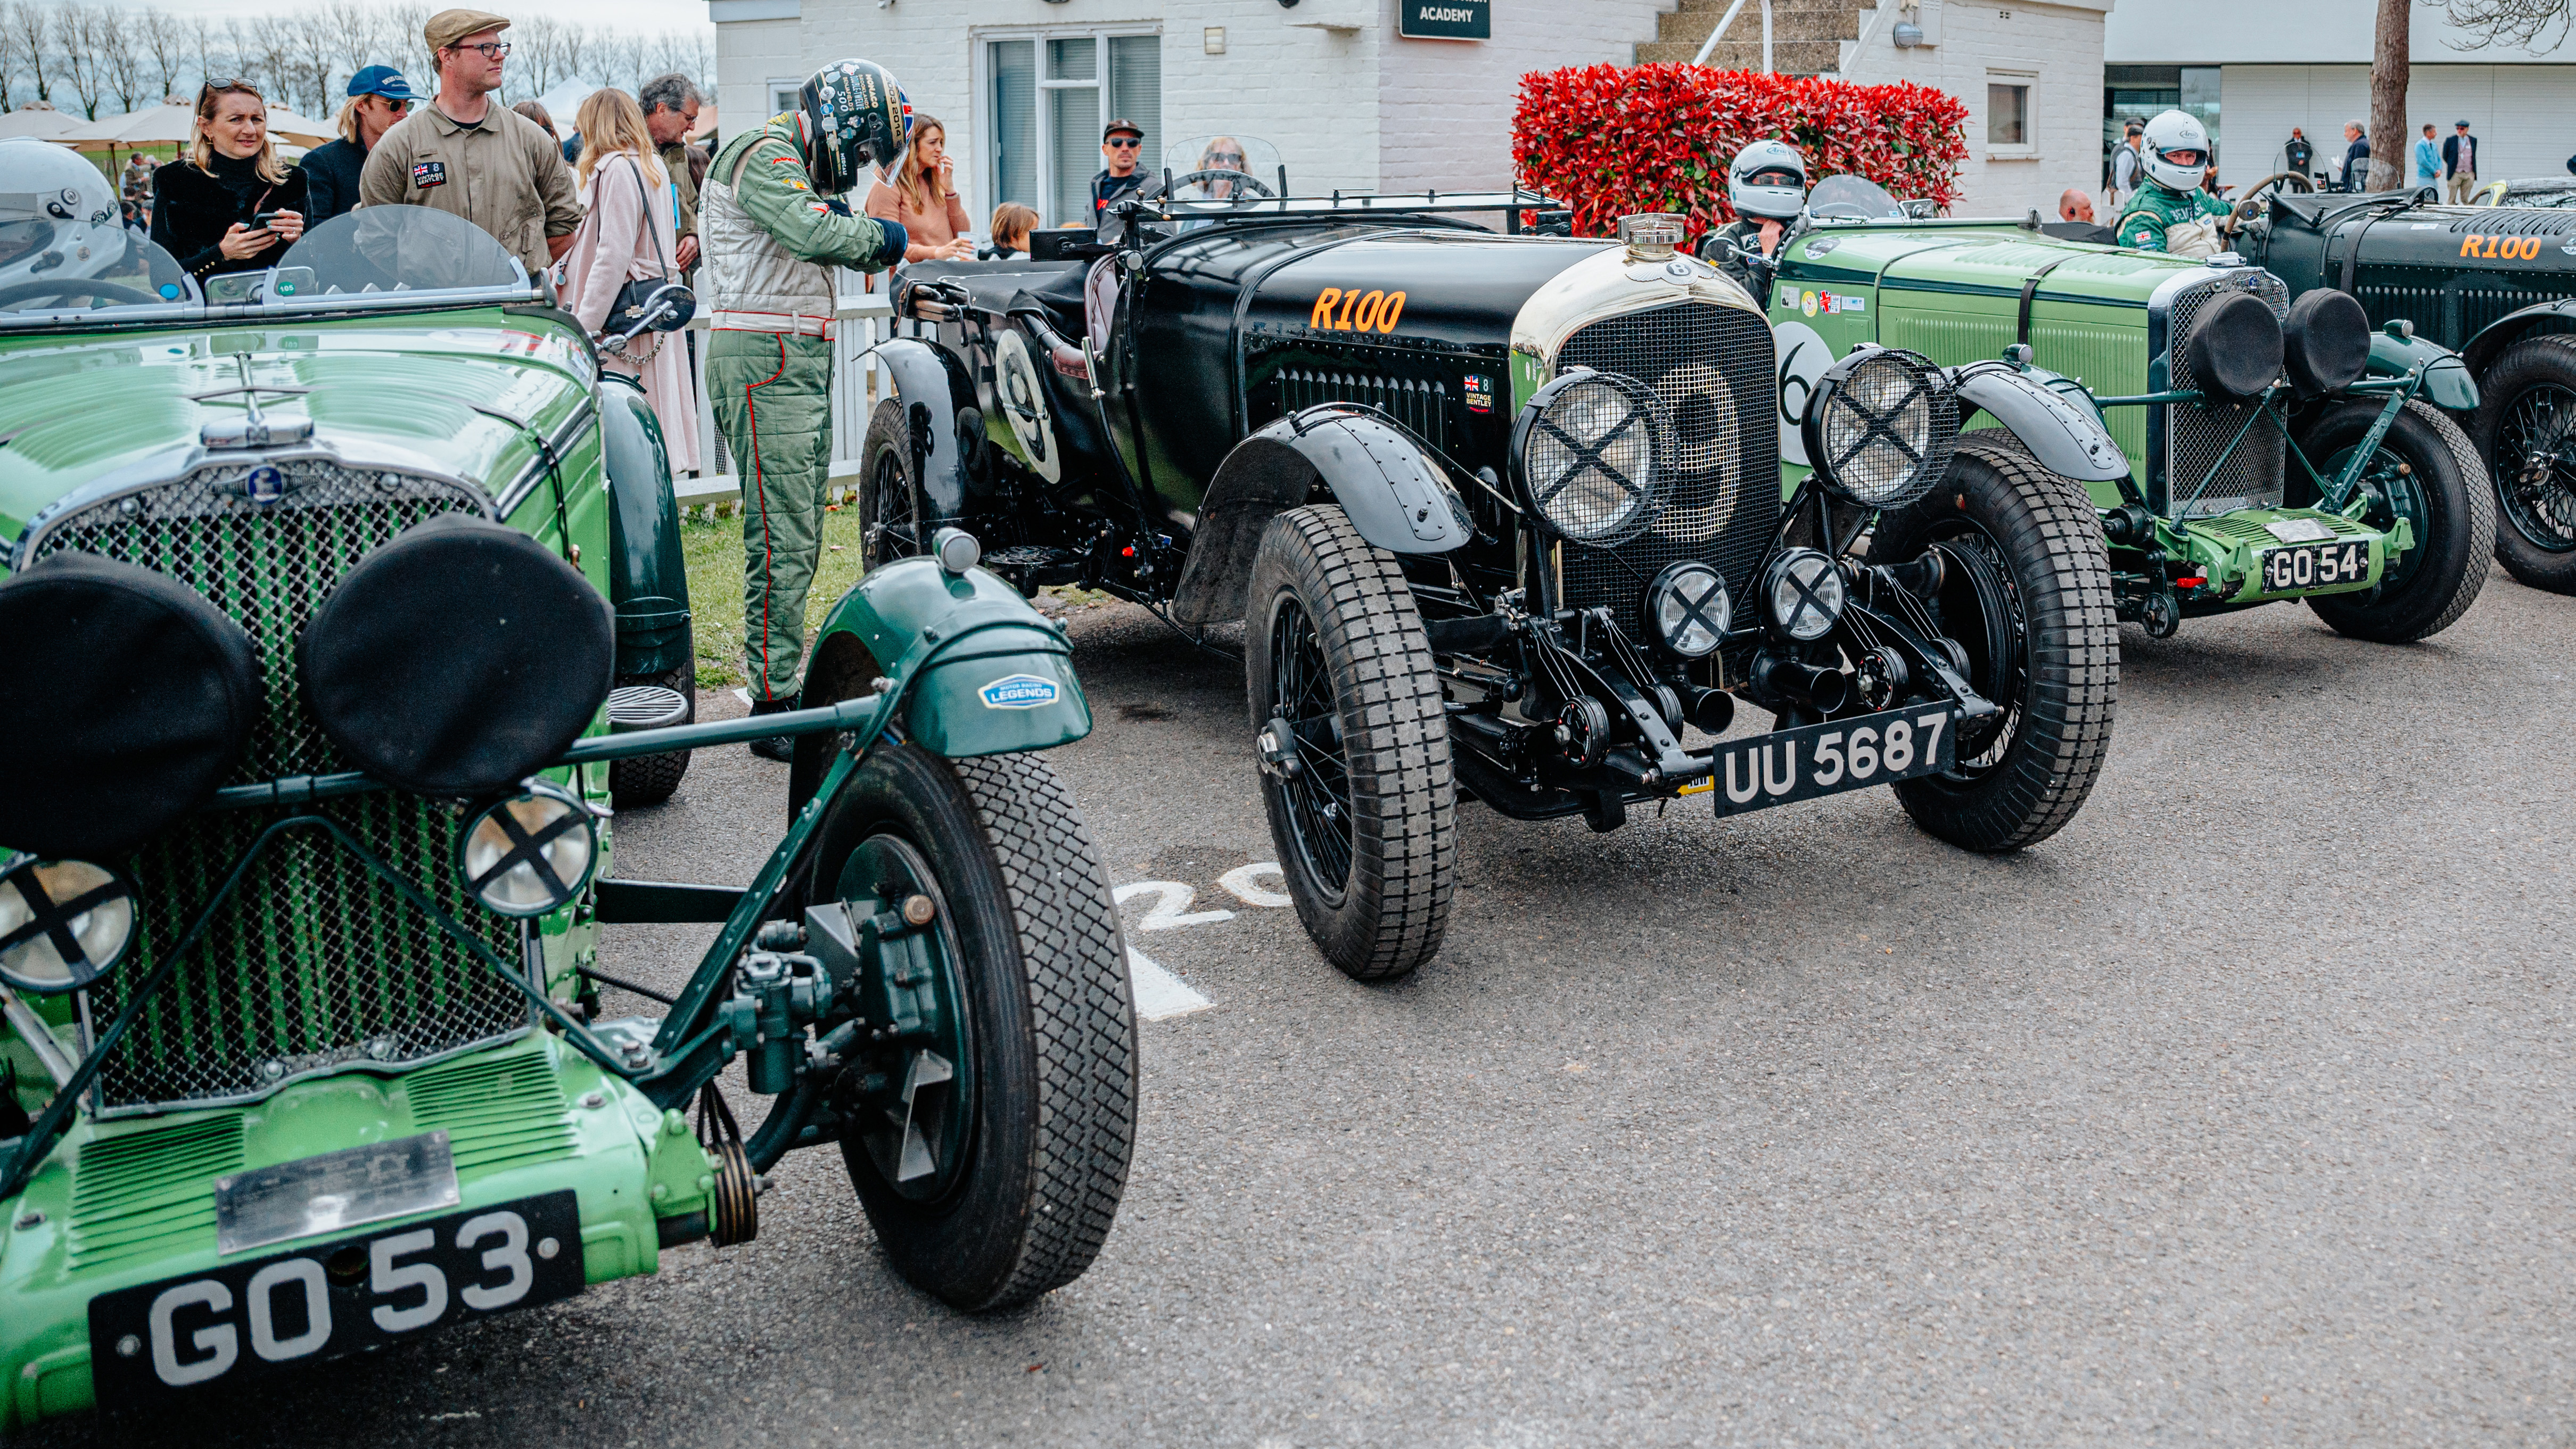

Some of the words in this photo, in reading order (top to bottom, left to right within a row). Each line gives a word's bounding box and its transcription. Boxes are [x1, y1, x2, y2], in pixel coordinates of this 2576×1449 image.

[1419, 6, 1474, 22] ACADEMY
[837, 90, 849, 112] 500
[858, 75, 870, 109] BROOKLANDS
[865, 74, 879, 108] MONACO
[892, 107, 901, 137] 2014
[417, 172, 443, 182] VINTAGE
[418, 176, 444, 185] BENTLEY
[433, 163, 440, 172] 8
[2459, 234, 2541, 260] R100
[1311, 287, 1406, 334] R100
[1466, 392, 1492, 401] VINTAGE
[1483, 378, 1489, 392] 8
[1779, 341, 1811, 426] 6
[1466, 398, 1492, 407] BENTLEY
[1644, 362, 1741, 543] 9
[2274, 549, 2312, 588] GO
[2319, 545, 2358, 582] 54
[991, 688, 1053, 703] LEGENDS
[1725, 740, 1796, 803] UU
[1813, 711, 1947, 786] 5687
[148, 1257, 333, 1387] GO
[369, 1211, 533, 1333] 53
